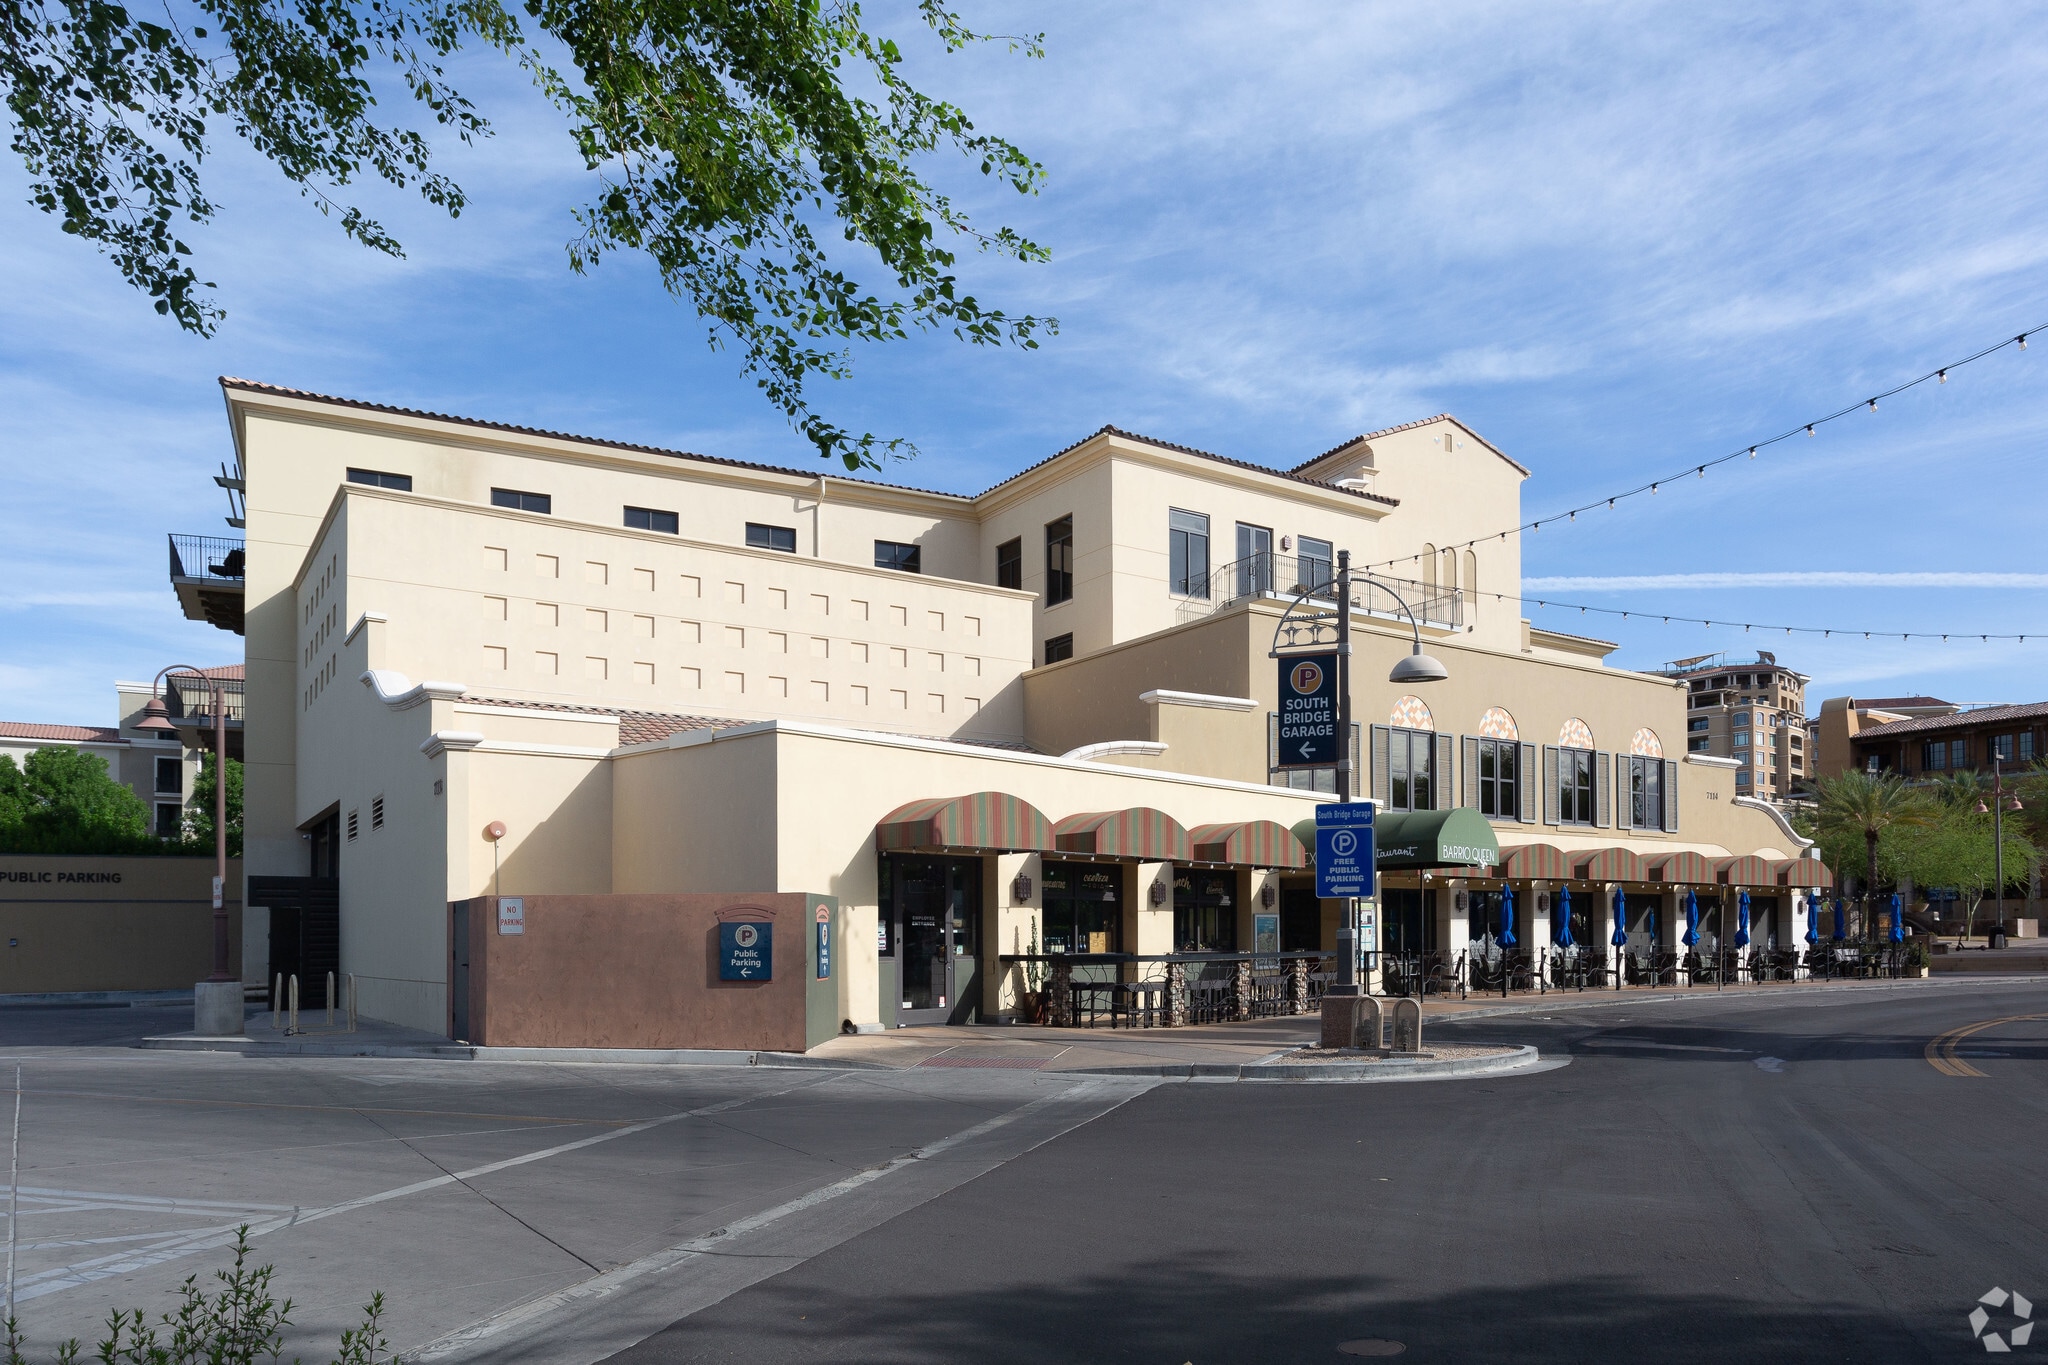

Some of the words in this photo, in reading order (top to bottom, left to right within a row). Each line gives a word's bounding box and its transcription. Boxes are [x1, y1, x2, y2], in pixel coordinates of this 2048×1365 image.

[1299, 668, 1318, 688] P
[1286, 697, 1329, 710] SOUTH
[1284, 711, 1331, 724] BRIDGE
[1281, 725, 1333, 738] GARAGE
[1706, 791, 1719, 800] 7114
[1317, 810, 1333, 819] South
[1334, 810, 1351, 820] Bridge
[1352, 809, 1371, 819] Garage
[1339, 835, 1351, 852] P
[1442, 845, 1471, 860] BARRIO
[1472, 847, 1495, 862] QUEEN
[1329, 866, 1360, 874] PUBLIC
[0, 872, 52, 883] PUBLIC
[57, 872, 122, 883] PARKING
[1325, 875, 1365, 883] PARKING
[500, 918, 523, 926] PARKING
[741, 929, 753, 942] P
[734, 949, 759, 958] Public
[731, 958, 762, 968] Parking
